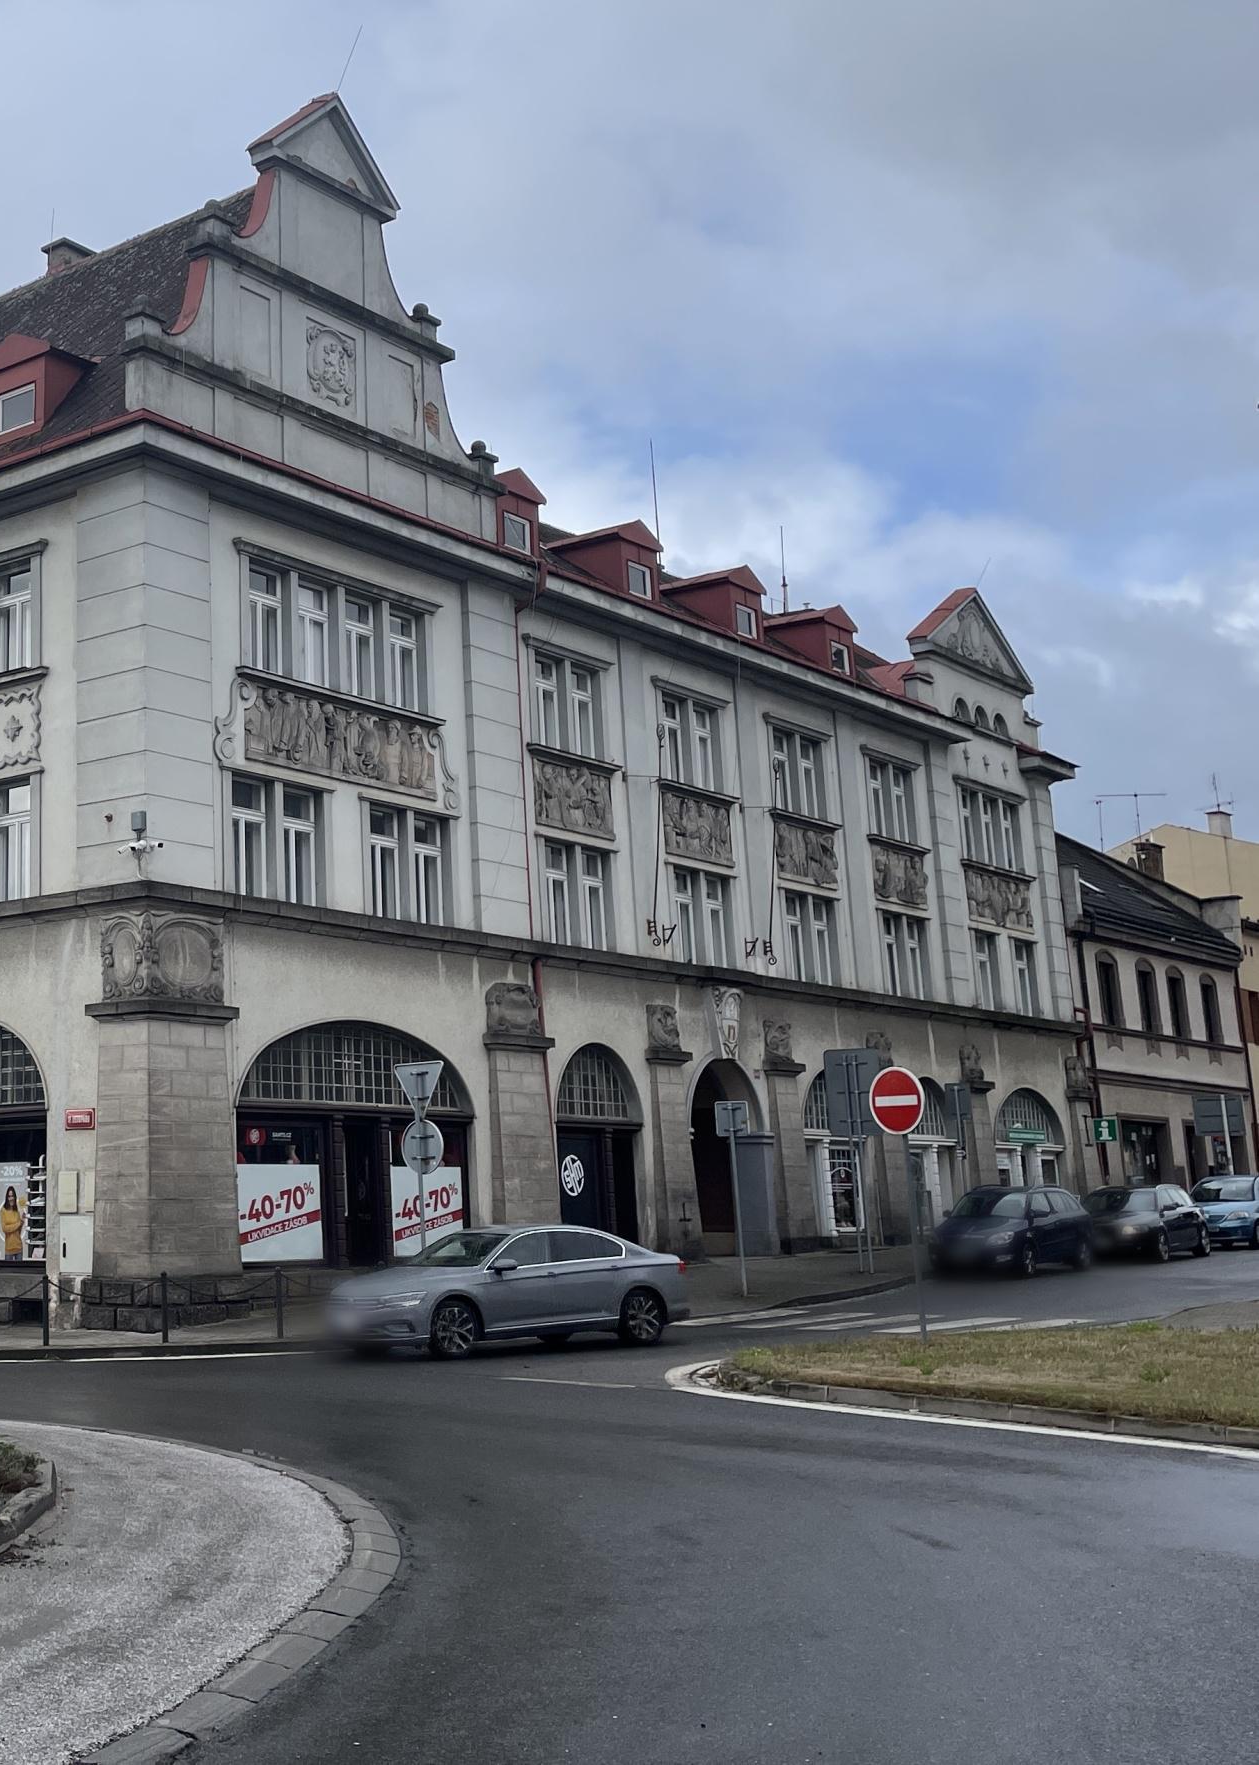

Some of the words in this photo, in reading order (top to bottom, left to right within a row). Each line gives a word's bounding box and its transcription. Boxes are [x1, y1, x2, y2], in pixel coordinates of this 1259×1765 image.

[0, 1166, 23, 1177] -20%
[248, 1223, 284, 1242] LIKVIDACE
[284, 1216, 308, 1232] ZÁSOB
[401, 1221, 433, 1238] LIKVIDCE
